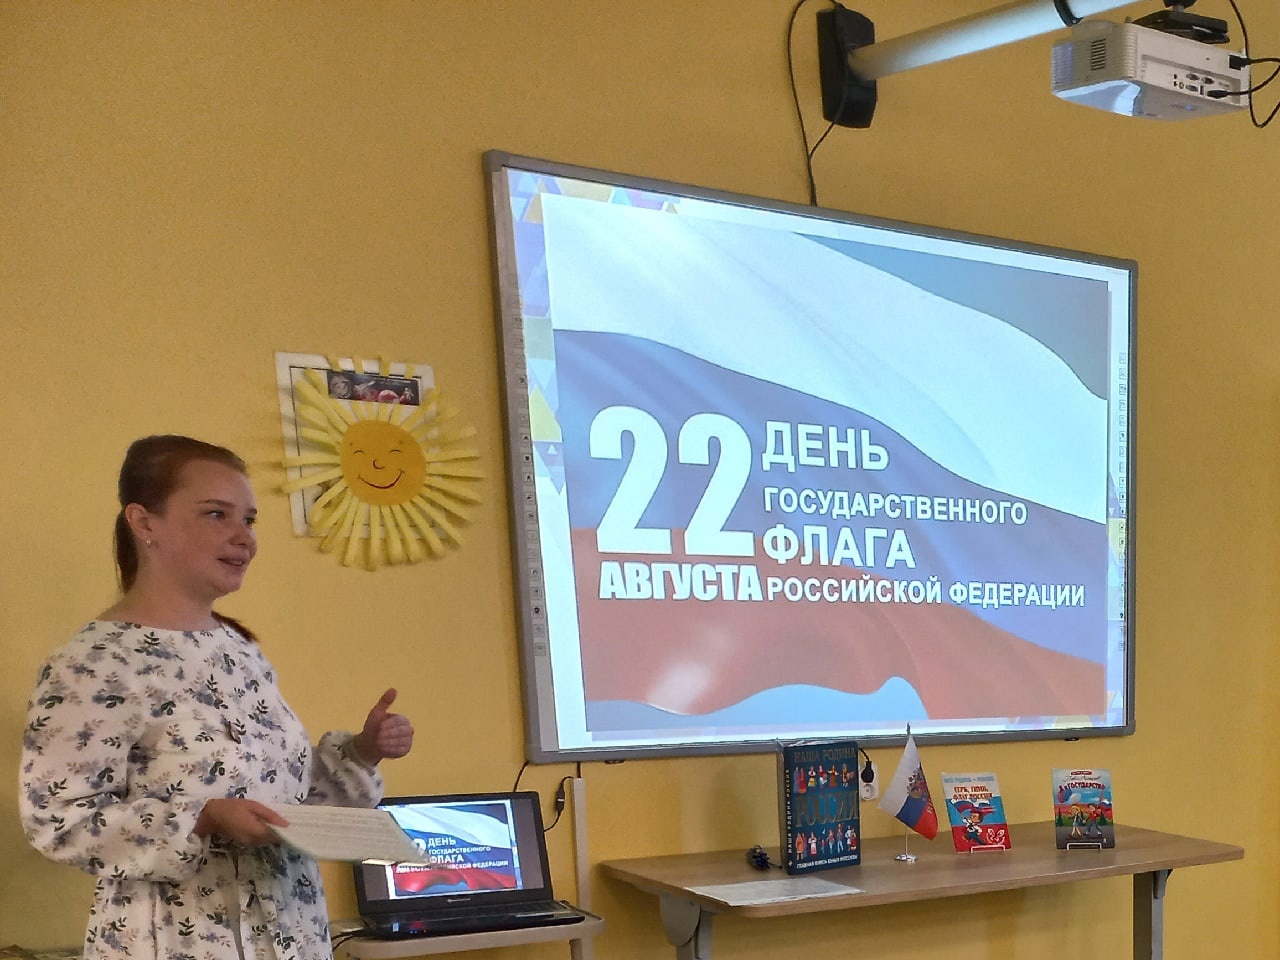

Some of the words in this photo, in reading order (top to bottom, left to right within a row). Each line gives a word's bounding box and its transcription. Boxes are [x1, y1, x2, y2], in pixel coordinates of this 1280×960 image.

[761, 420, 890, 473] ДЕНЬ
[589, 405, 756, 557] 22
[763, 486, 1028, 525] ГОСУДАРСТВЕННОГО
[762, 523, 917, 569] ФЛАГА
[598, 560, 763, 601] АВГУСТА
[766, 574, 942, 604] РОССИЙСКОЙ
[949, 581, 1085, 610] ФЕДЕРАЦИИ
[428, 837, 457, 847] ДЕНЬ
